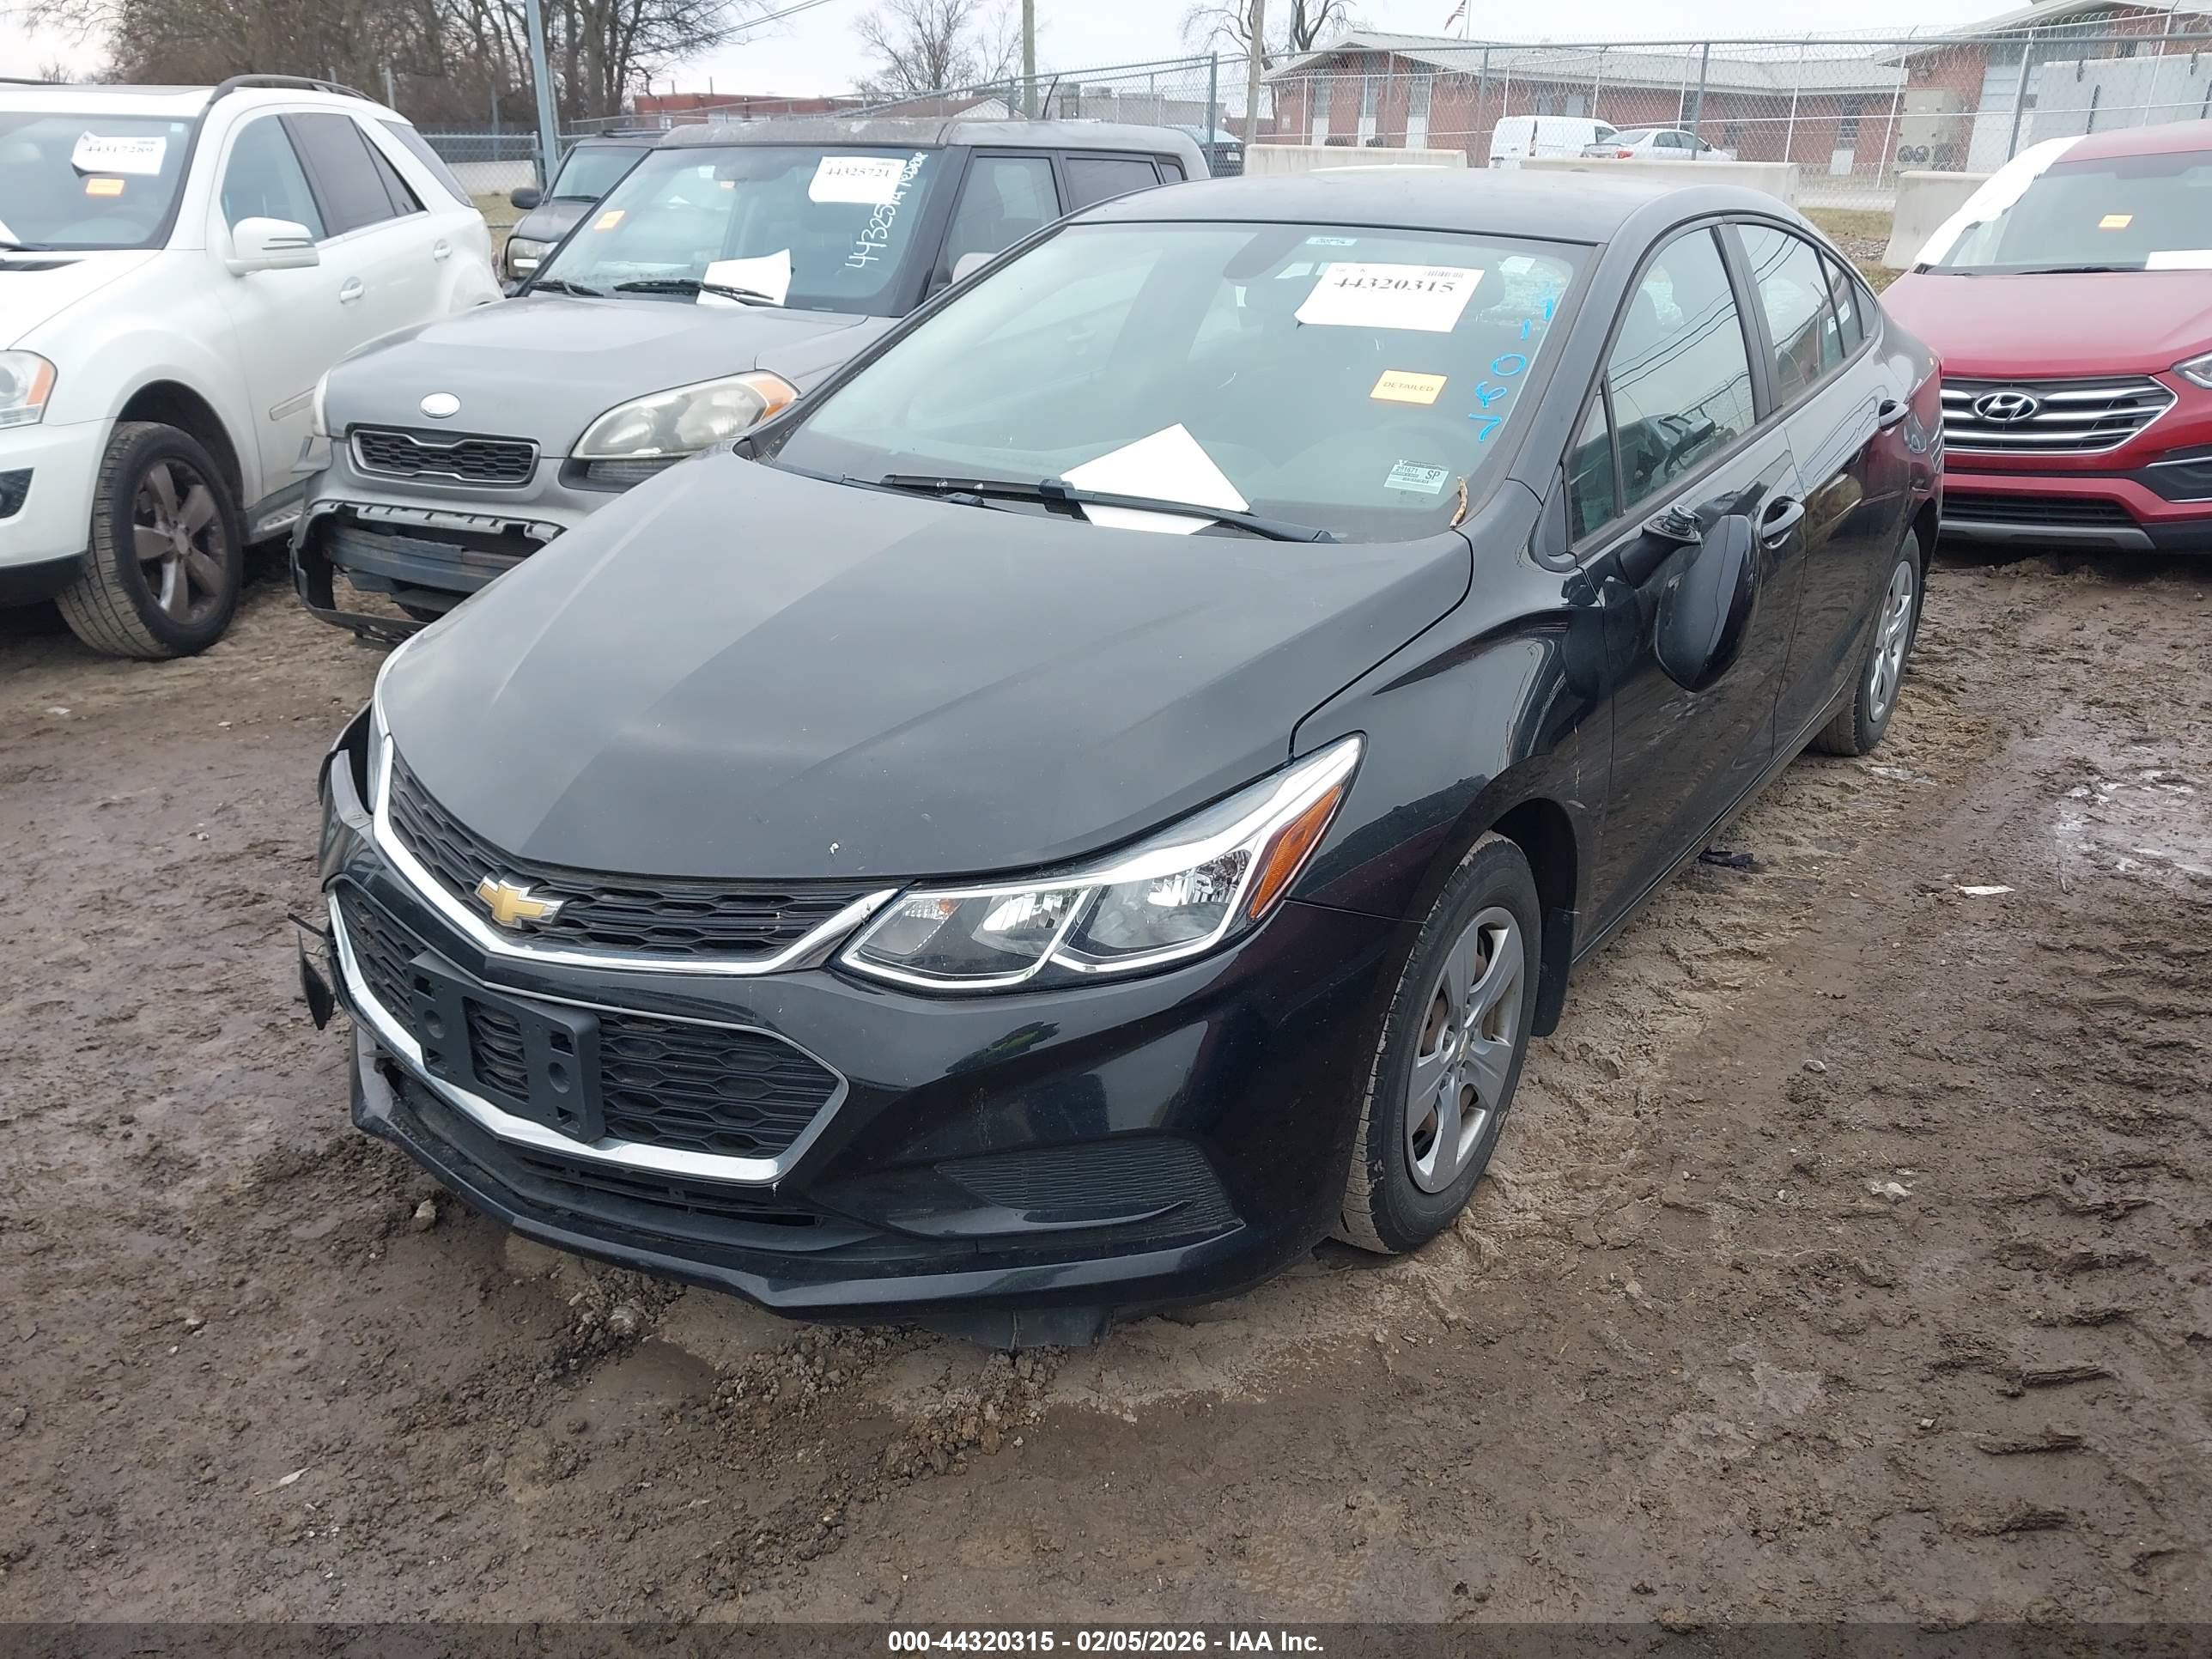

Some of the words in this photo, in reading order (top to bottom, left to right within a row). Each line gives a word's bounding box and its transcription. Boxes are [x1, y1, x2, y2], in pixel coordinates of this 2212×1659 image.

[825, 167, 890, 179] 44325721
[1334, 276, 1457, 293] 44320315
[1382, 381, 1434, 392] DETAILED
[1425, 470, 1441, 480] SP
